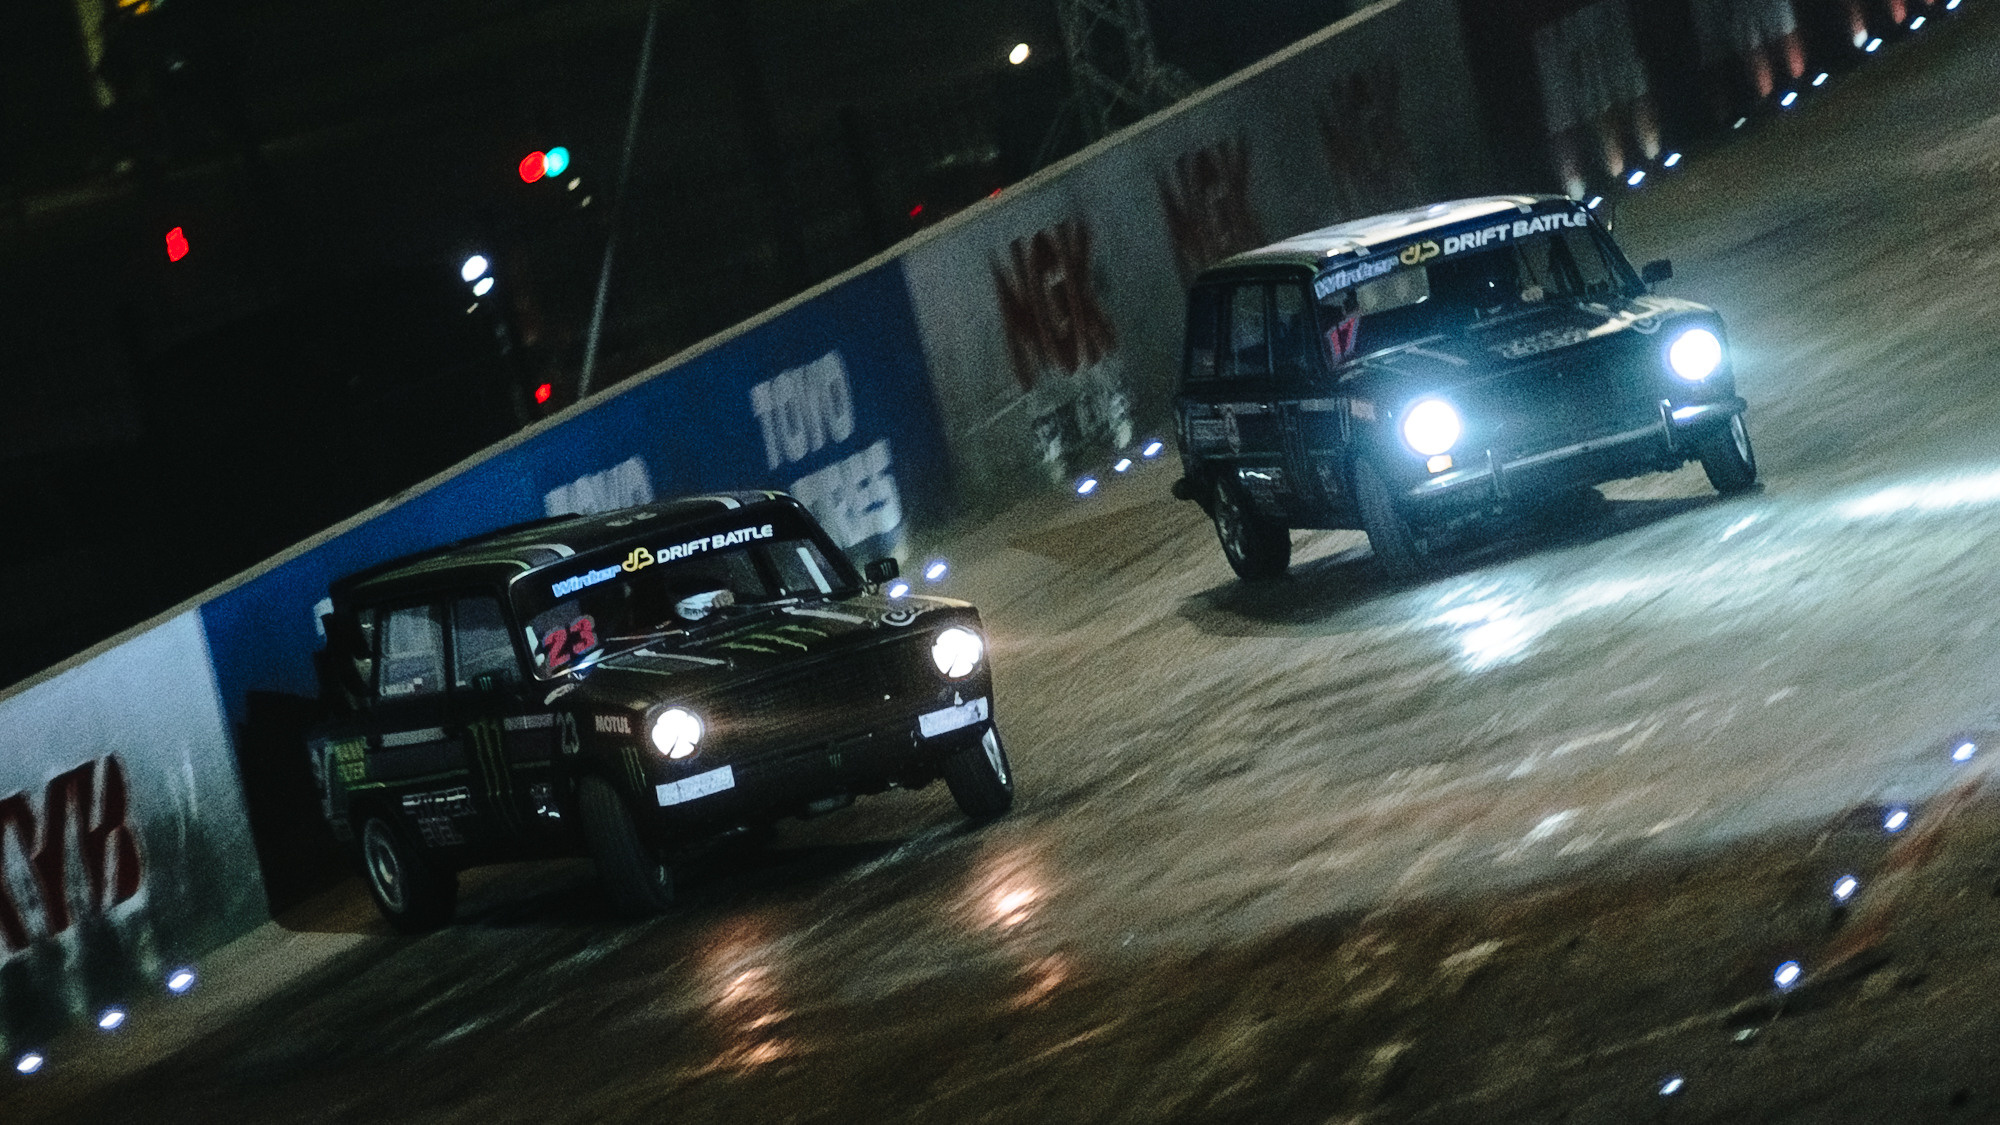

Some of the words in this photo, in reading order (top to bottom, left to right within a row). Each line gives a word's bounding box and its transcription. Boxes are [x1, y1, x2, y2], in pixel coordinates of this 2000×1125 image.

[1444, 223, 1511, 256] DRIFT
[1512, 211, 1588, 239] BATTLE
[552, 564, 622, 598] Winter
[656, 536, 711, 564] DRIFT
[712, 523, 774, 550] BATTLE
[544, 617, 596, 668] 23
[594, 715, 632, 735] MOTUL
